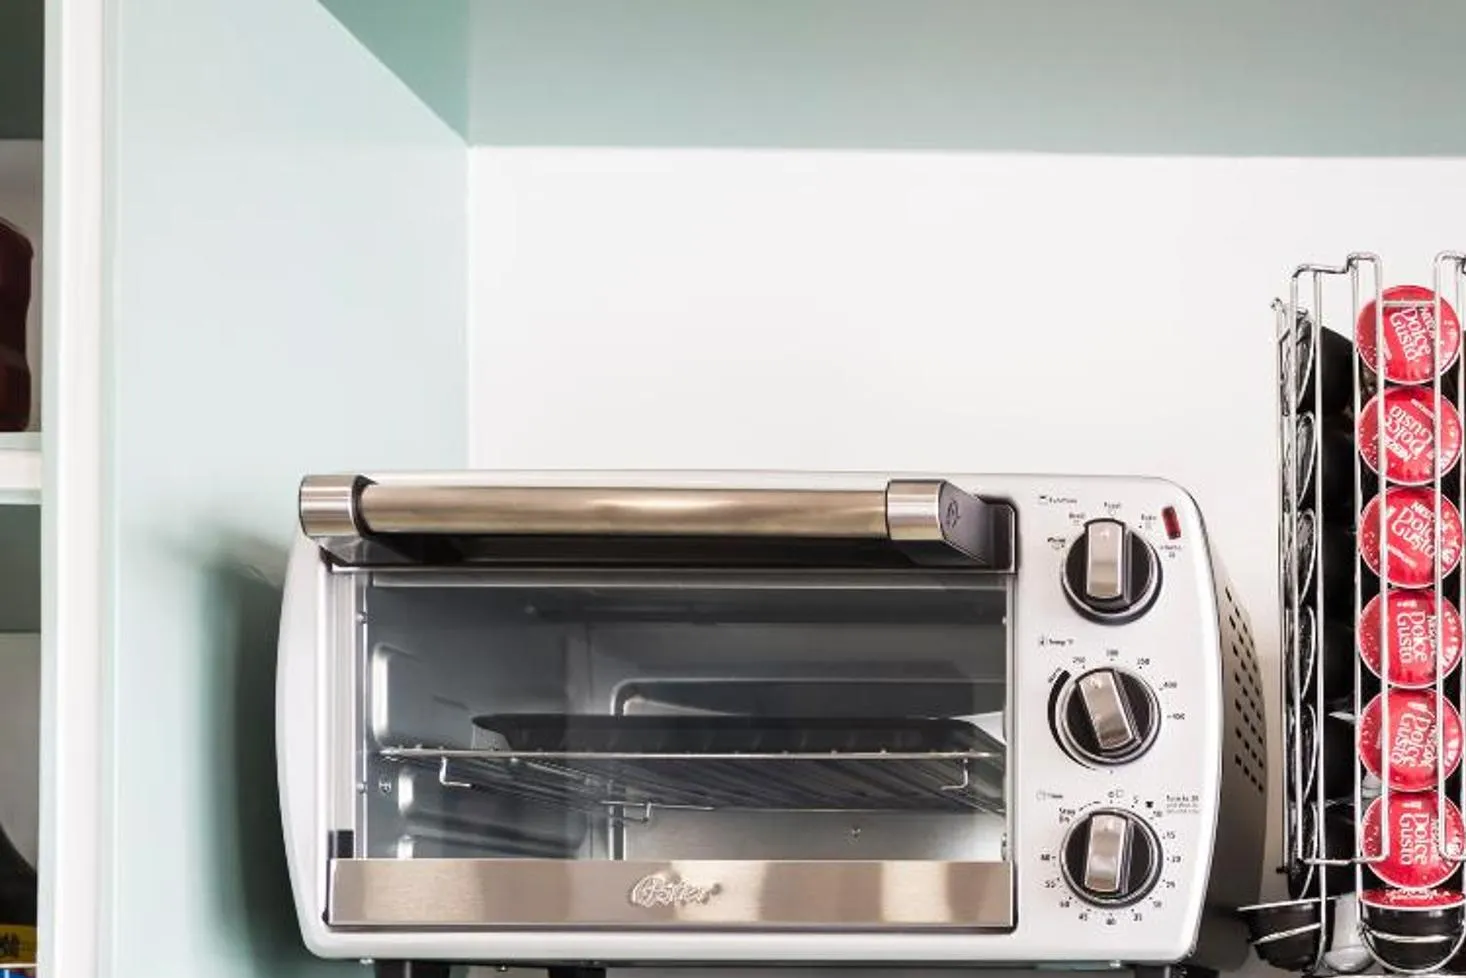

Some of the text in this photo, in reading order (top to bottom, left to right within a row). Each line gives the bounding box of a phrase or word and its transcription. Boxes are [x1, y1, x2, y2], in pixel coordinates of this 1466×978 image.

[1390, 312, 1420, 361] Gusto
[1401, 306, 1431, 357] Dolce
[1385, 415, 1425, 460] Dolce
[1390, 405, 1432, 447] Gusto
[1397, 507, 1436, 540] Dolc
[1397, 614, 1412, 664] Gusto
[1411, 611, 1428, 662] Dolce
[1391, 713, 1415, 765] Gusto
[1401, 713, 1431, 767] Dolce
[1401, 813, 1414, 865] Gusto
[1414, 813, 1429, 865] Dolce
